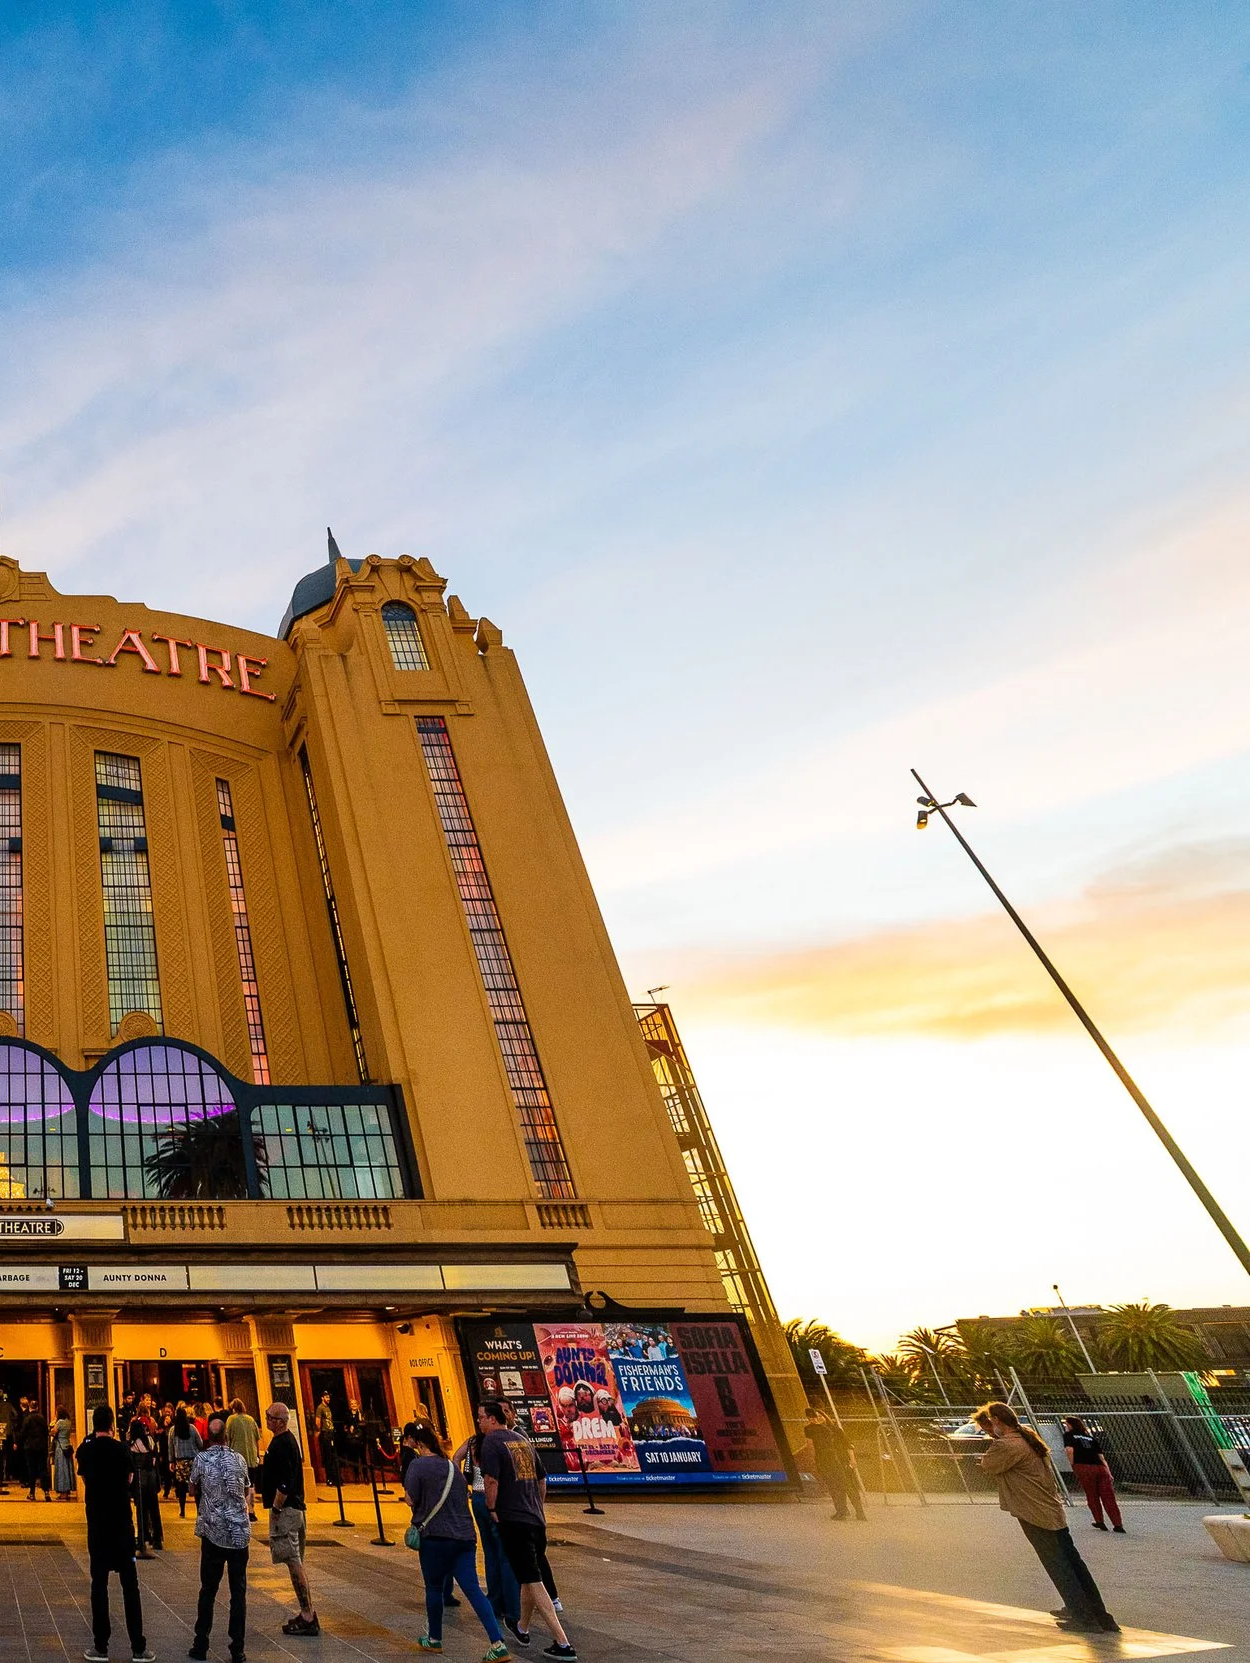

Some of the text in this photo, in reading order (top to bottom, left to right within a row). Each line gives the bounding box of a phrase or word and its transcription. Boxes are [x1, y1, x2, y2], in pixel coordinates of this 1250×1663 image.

[103, 1274, 167, 1282] AUNTY DONNA
[676, 1327, 738, 1349] SOFIA
[485, 1340, 523, 1350] WHAT'S
[159, 1347, 167, 1358] D
[476, 1351, 536, 1360] COMING UP!
[556, 1347, 595, 1364] AUNTY
[681, 1351, 749, 1375] ISELLA
[554, 1361, 608, 1387] DONNA
[618, 1365, 679, 1376] FISHERMAN'S
[621, 1376, 684, 1391] FRIENDS
[572, 1417, 617, 1441] DREM
[645, 1452, 660, 1463] SAT
[660, 1452, 669, 1463] 10
[669, 1451, 702, 1463] JANUARY
